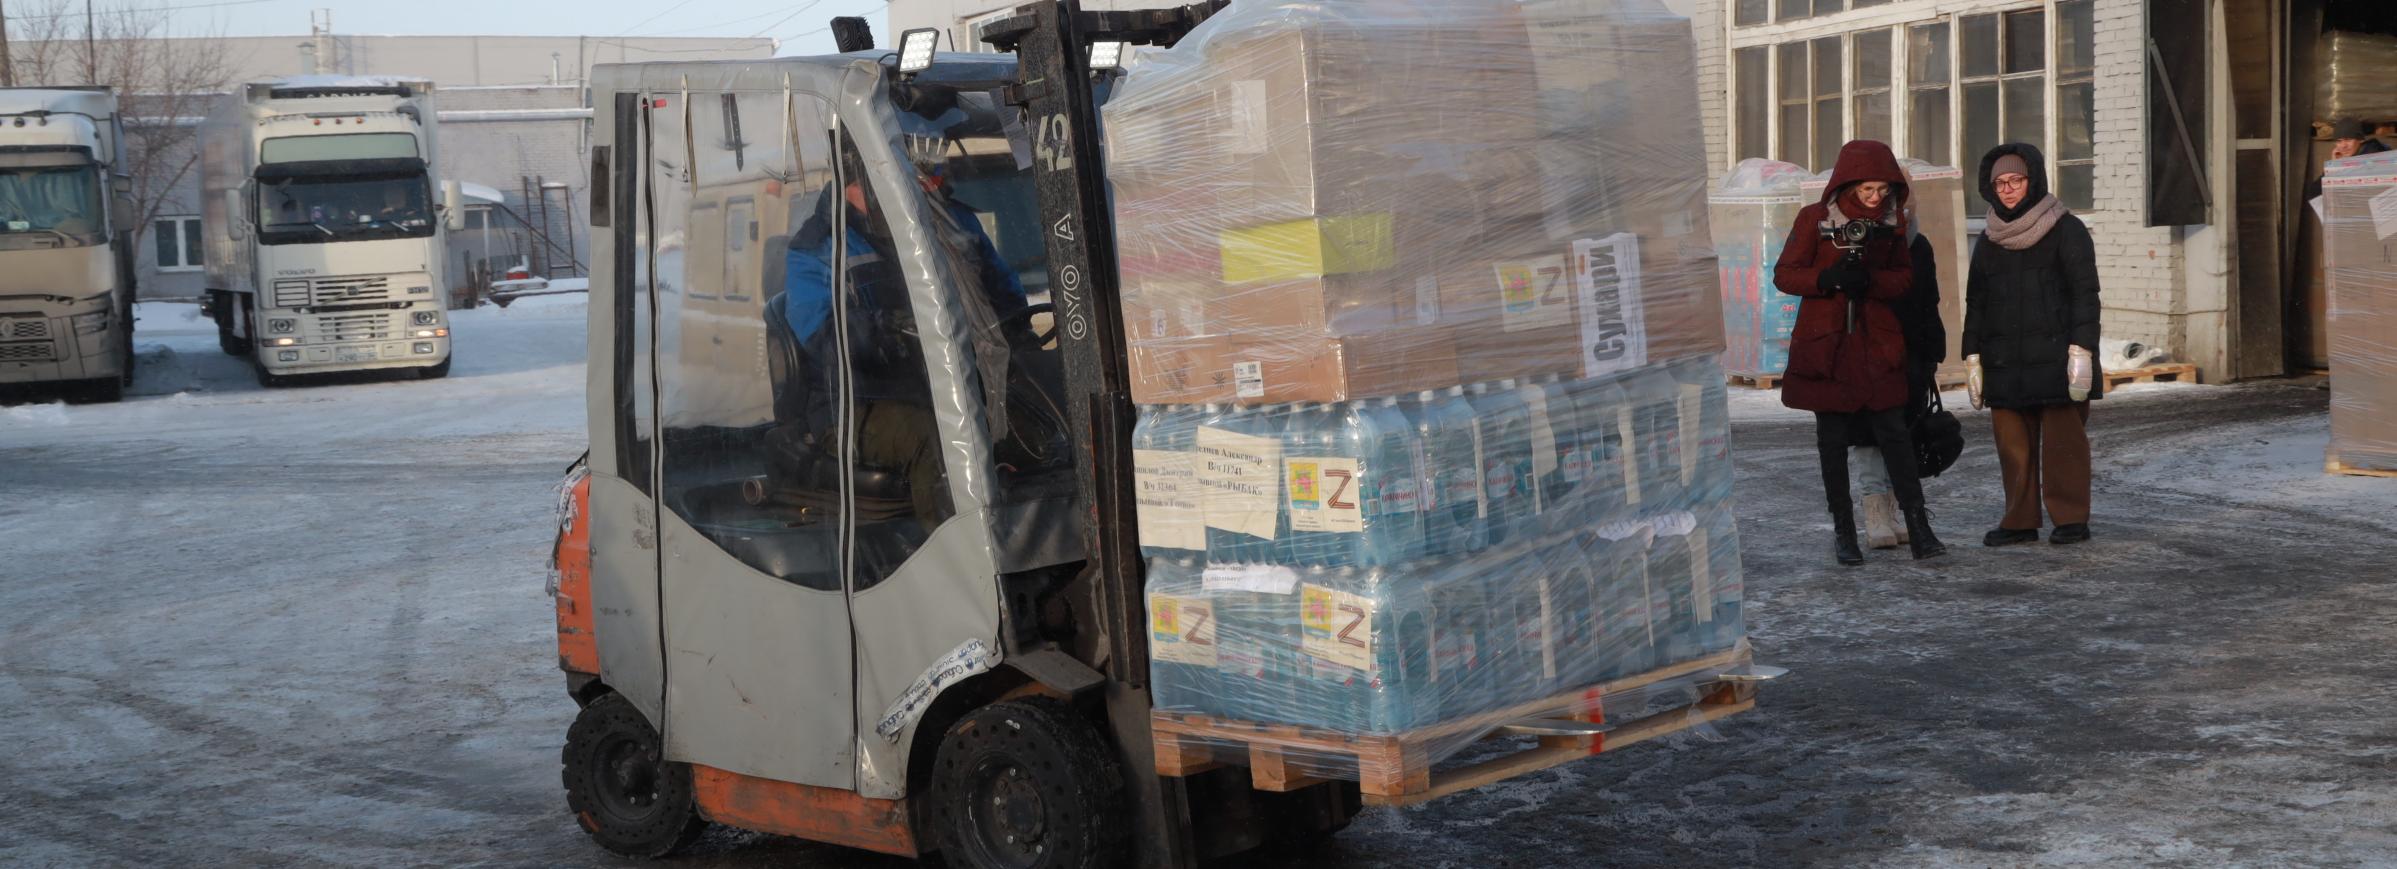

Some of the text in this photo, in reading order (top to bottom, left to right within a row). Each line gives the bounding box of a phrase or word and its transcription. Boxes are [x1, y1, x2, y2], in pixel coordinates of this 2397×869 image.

[1036, 112, 1073, 172] 42
[1536, 266, 1566, 306] Z
[1588, 245, 1627, 361] Сухари
[1324, 469, 1356, 510] Z
[1183, 606, 1212, 646] Z
[1337, 603, 1366, 649] Z
